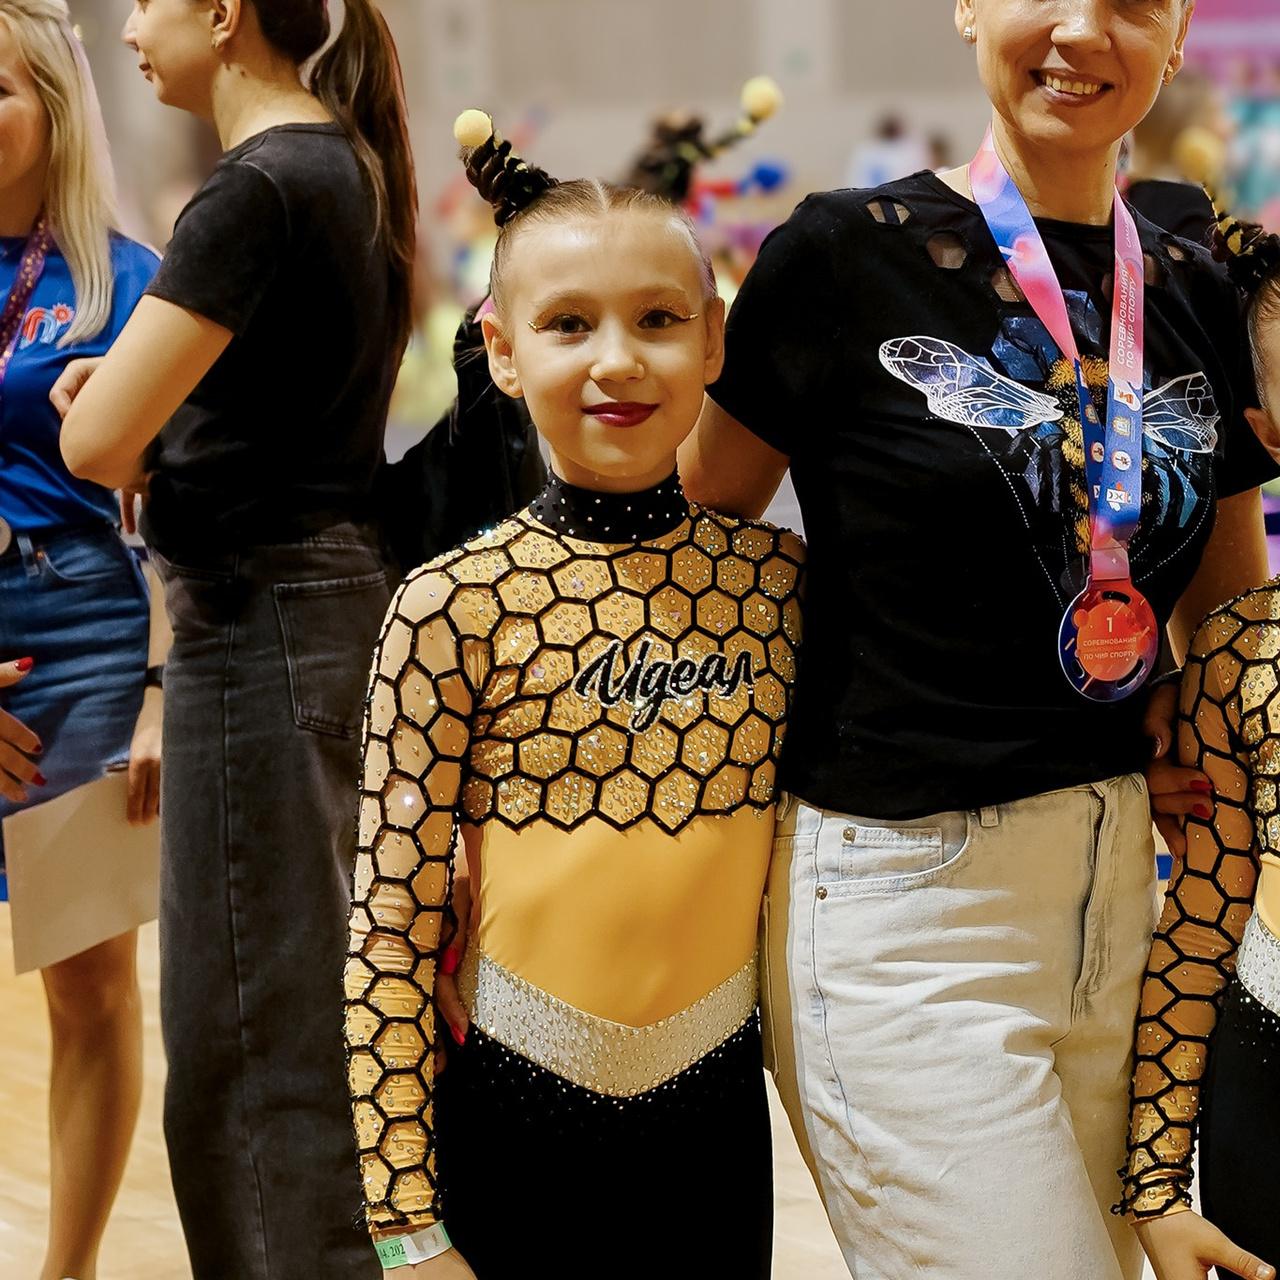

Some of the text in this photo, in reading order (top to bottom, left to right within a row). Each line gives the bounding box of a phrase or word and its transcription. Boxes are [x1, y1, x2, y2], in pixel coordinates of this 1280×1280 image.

[1117, 269, 1129, 365] СОРЕВНОВАНИЯ
[1126, 277, 1136, 369] ПО ЧИР СПОРТУ
[1083, 637, 1137, 646] СОРЕВНОВАНИЯ
[1106, 617, 1112, 632] 1
